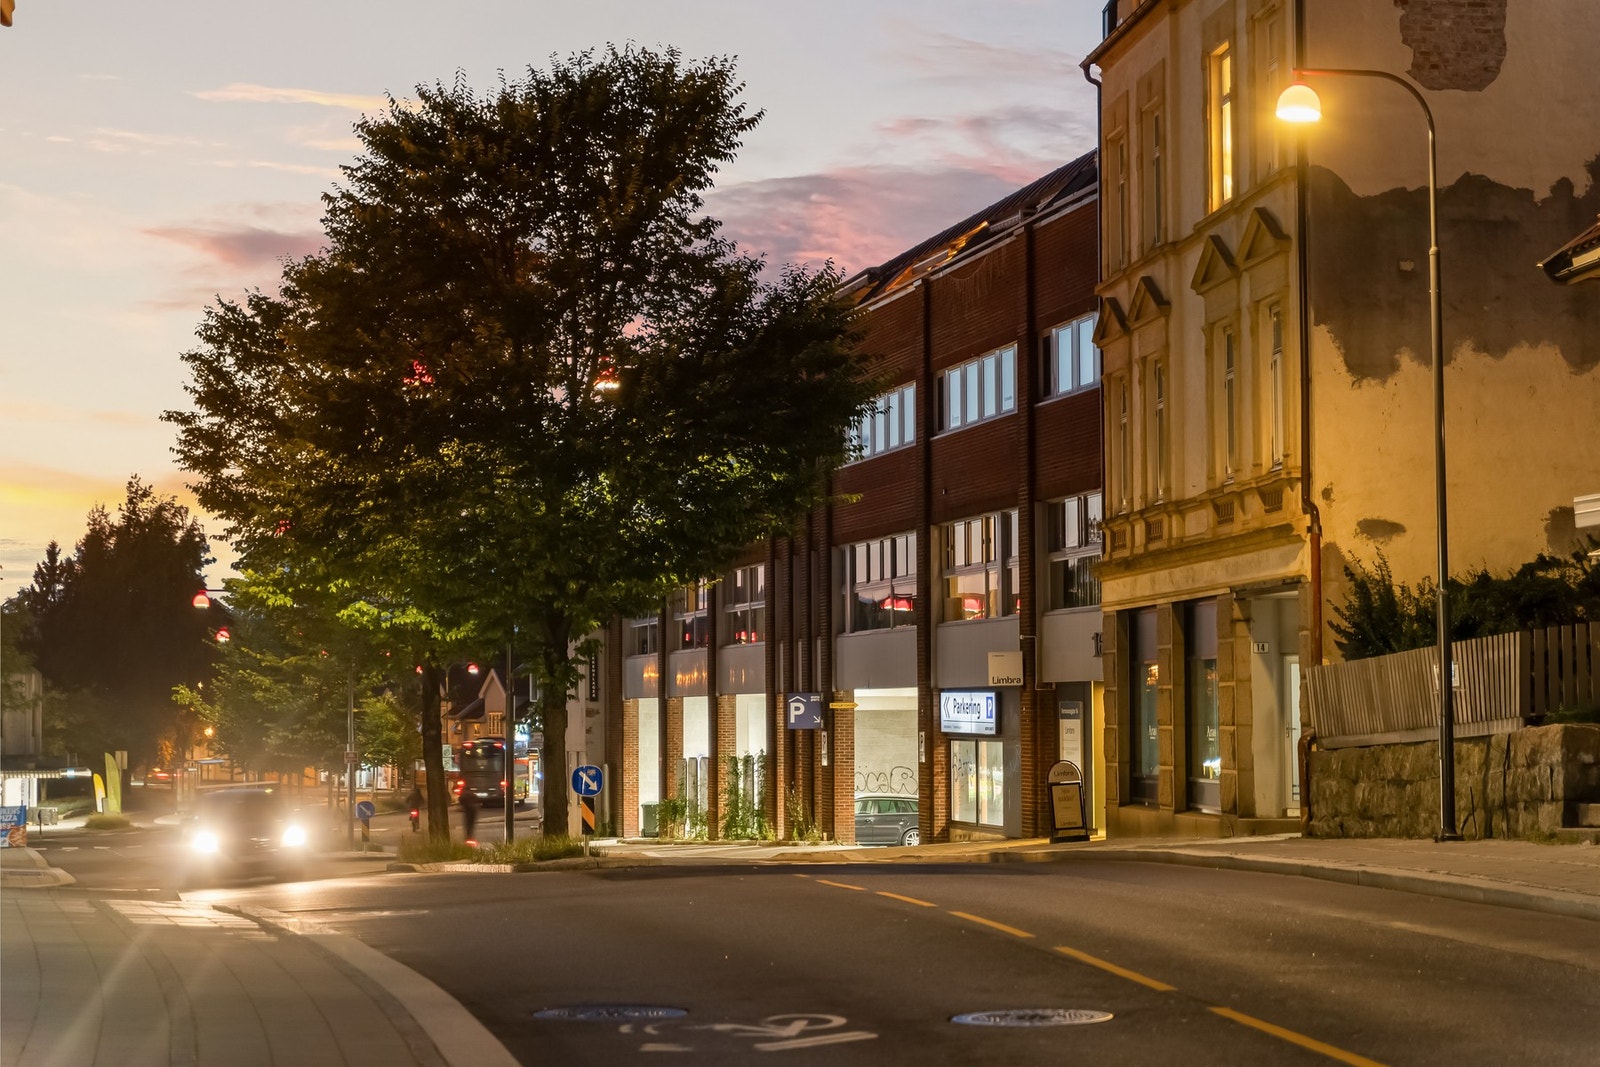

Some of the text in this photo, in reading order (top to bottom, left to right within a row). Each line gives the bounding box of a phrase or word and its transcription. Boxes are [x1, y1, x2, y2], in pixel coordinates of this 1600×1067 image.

[1256, 643, 1265, 652] 14
[992, 675, 1022, 685] Limbra
[790, 702, 805, 724] P
[952, 697, 981, 720] Parkering
